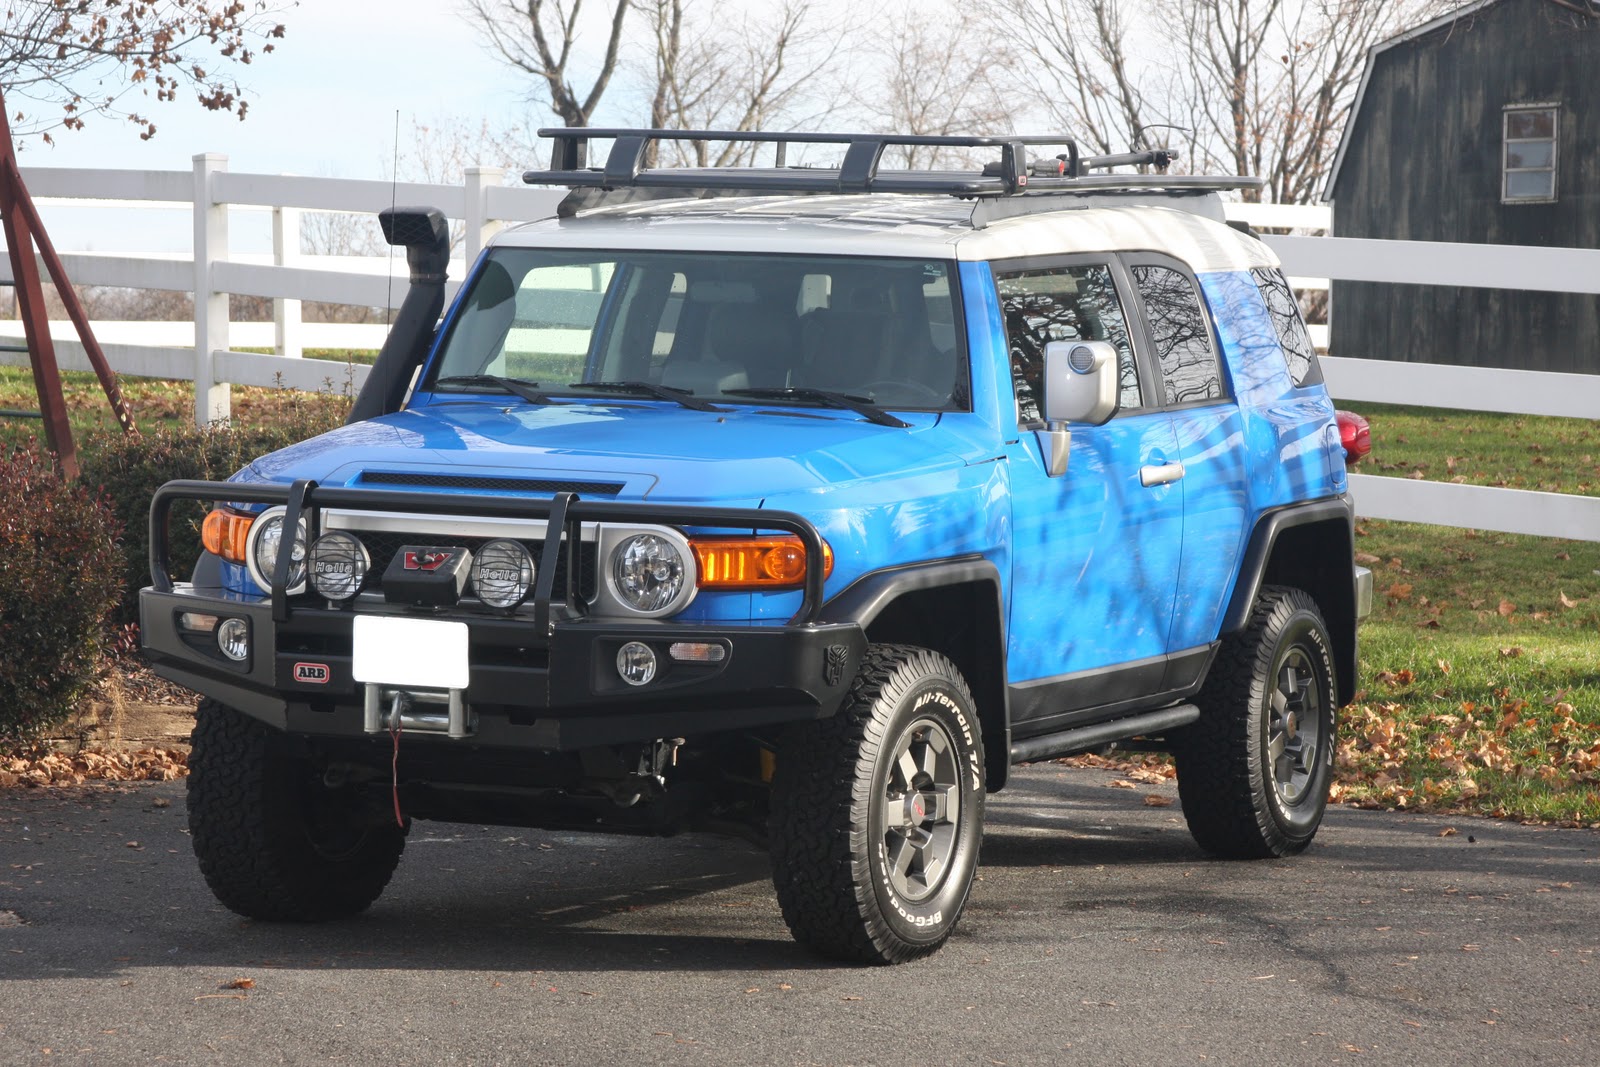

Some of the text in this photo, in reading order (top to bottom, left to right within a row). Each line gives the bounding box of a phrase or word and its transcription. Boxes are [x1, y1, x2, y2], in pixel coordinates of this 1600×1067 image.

[315, 562, 353, 573] Hella
[480, 568, 519, 581] Hella
[298, 666, 326, 679] ARB
[969, 749, 980, 791] T/A
